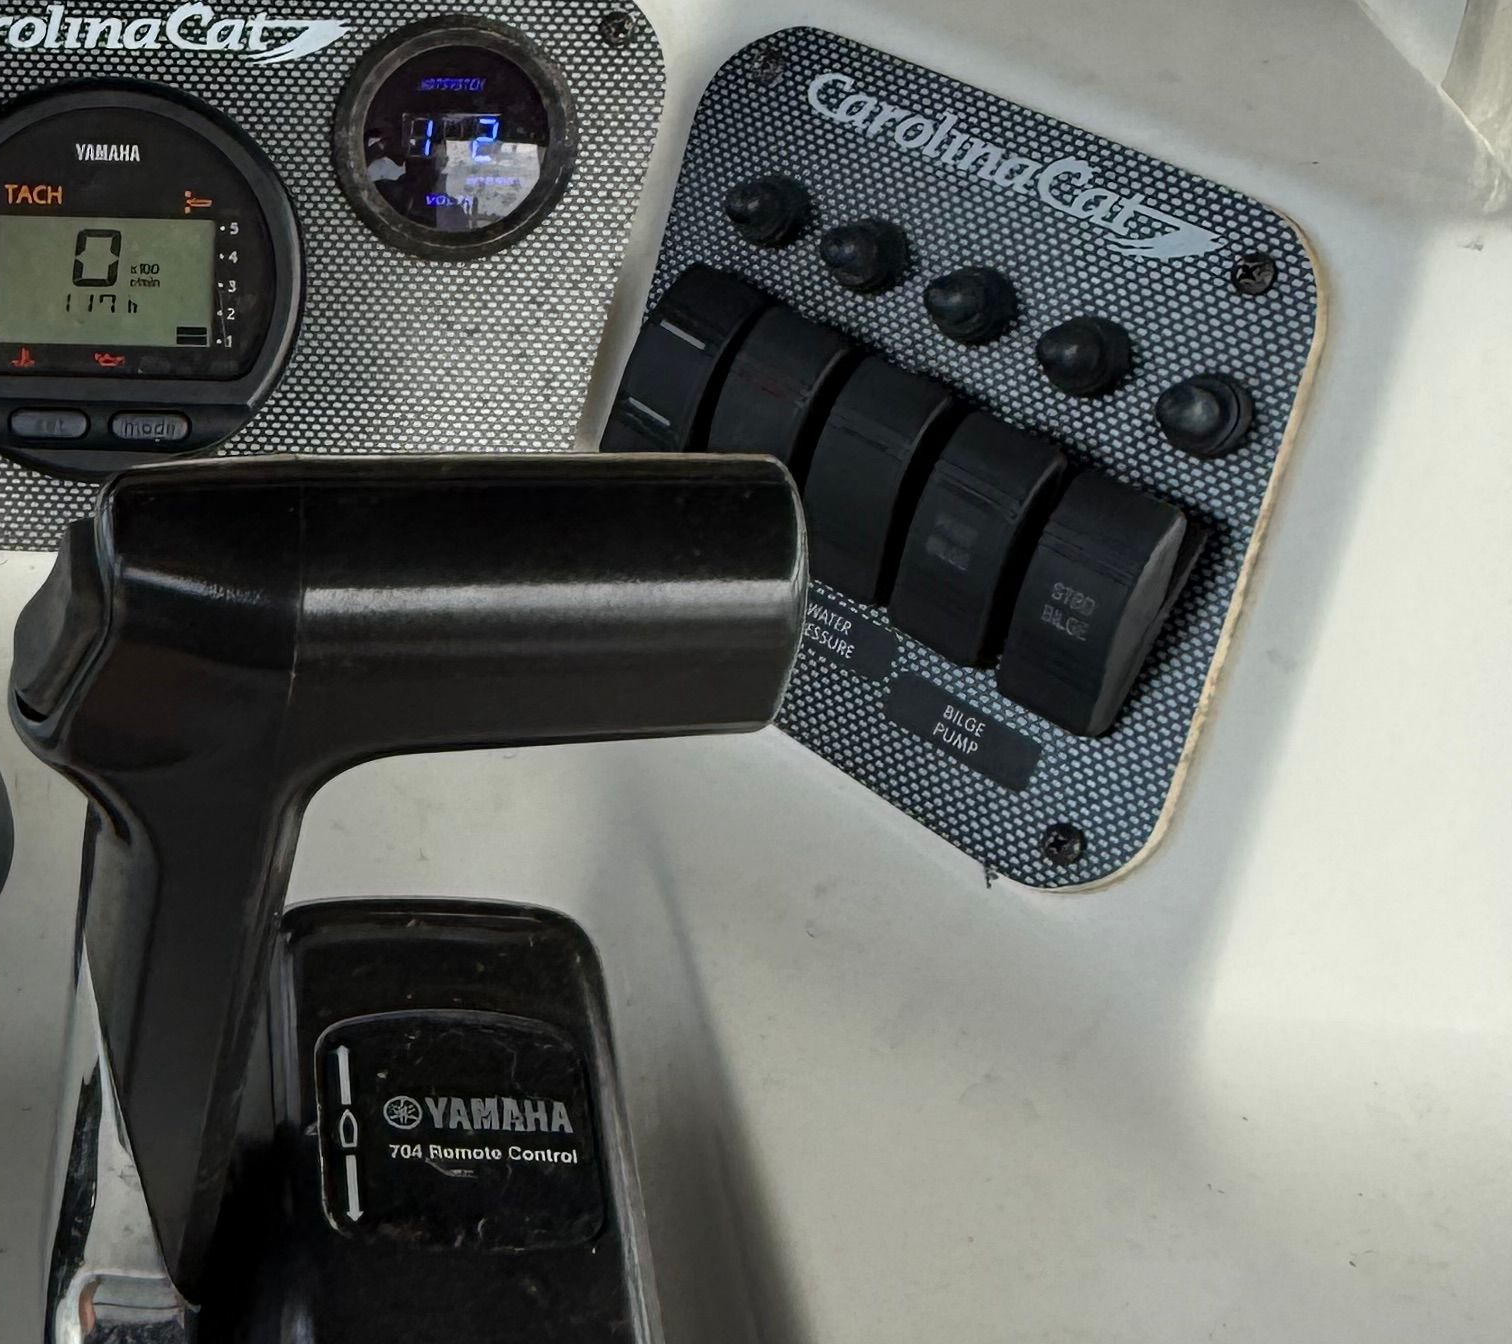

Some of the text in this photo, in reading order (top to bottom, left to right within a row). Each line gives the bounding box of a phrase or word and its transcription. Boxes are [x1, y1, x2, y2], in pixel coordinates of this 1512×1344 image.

[75, 142, 141, 163] YAMAHA
[4, 184, 64, 205] TACH
[229, 222, 239, 235] 5
[72, 229, 122, 287] 0
[228, 251, 238, 263] 4
[227, 280, 237, 293] 3
[226, 308, 236, 320] 2
[807, 602, 852, 636] WATER
[804, 623, 855, 659] ESSURE
[943, 704, 987, 738] BILGE
[932, 721, 979, 755] PUMP
[424, 1096, 574, 1134] YAMAHA
[389, 1144, 579, 1165] 704 Remote Control
